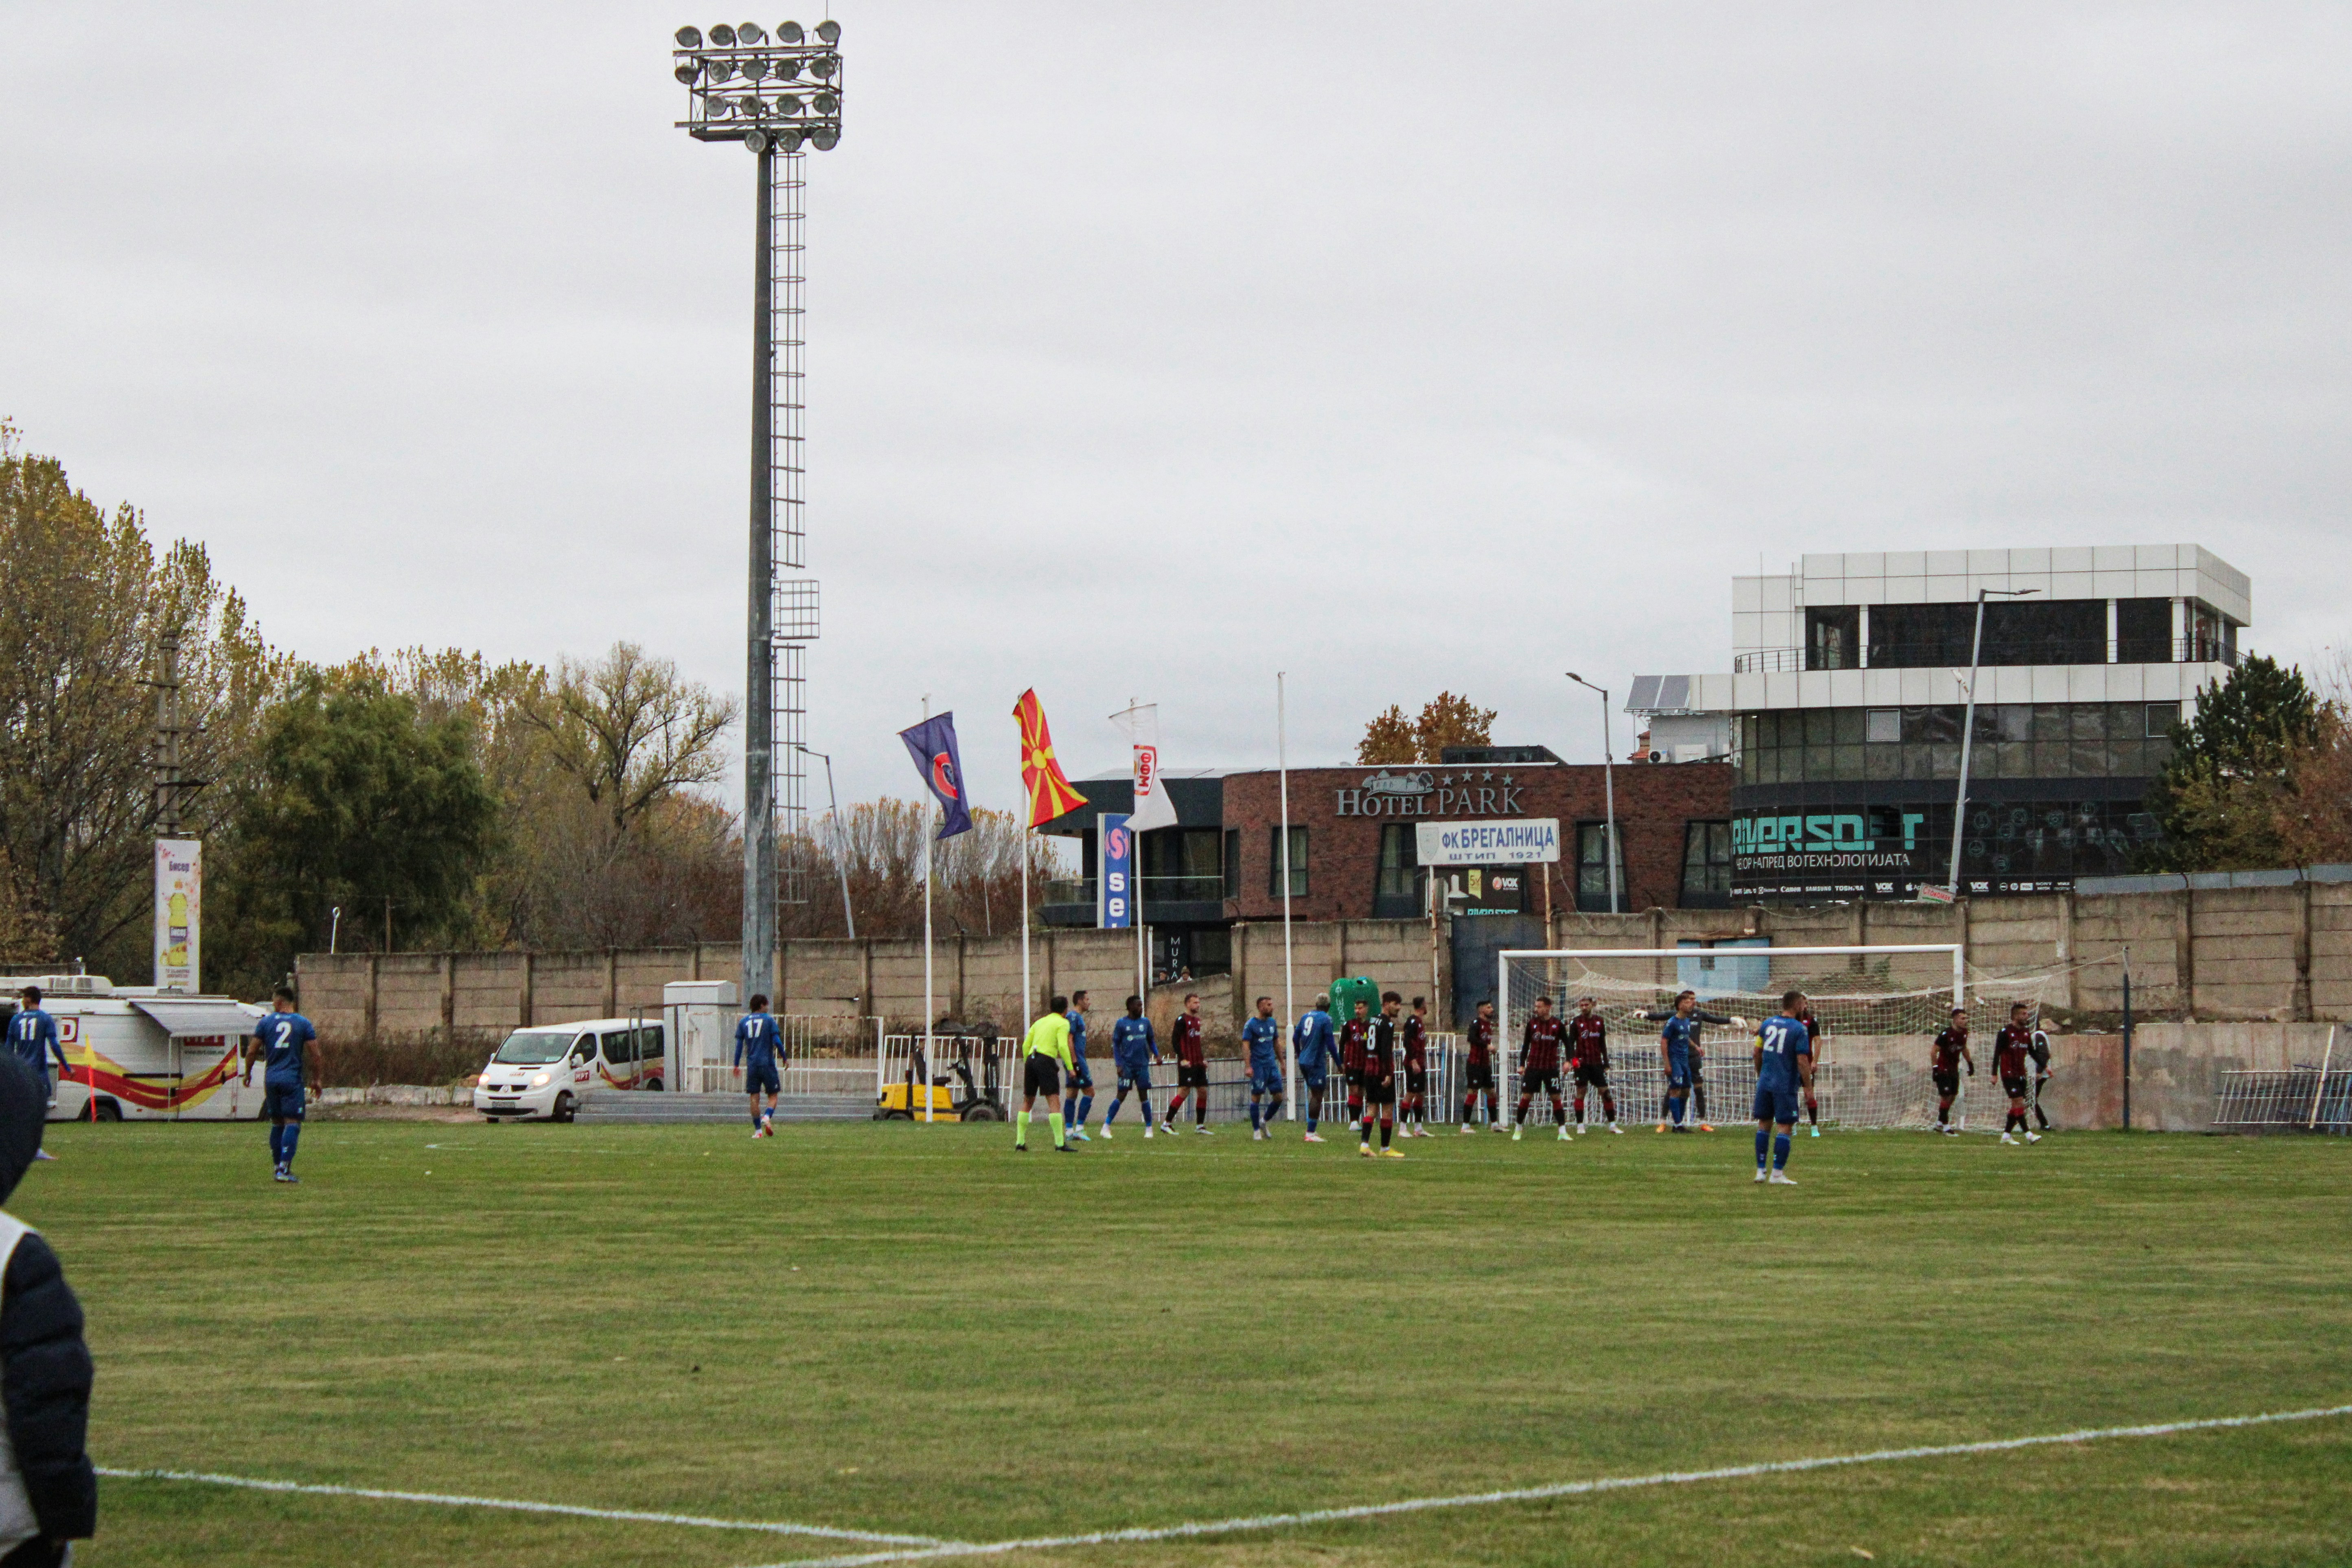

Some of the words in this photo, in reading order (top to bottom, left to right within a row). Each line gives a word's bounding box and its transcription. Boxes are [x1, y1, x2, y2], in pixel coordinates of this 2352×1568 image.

[1437, 787, 1524, 815] PARK
[1442, 832, 1459, 849] ФК
[1461, 826, 1554, 851] БРЕГАЛНИЦА
[1449, 852, 1496, 860] ШТИП
[1509, 851, 1541, 859] 1921
[1736, 857, 1752, 870] ЧЕОР
[1753, 856, 1785, 869] НАПРЕД
[1787, 856, 1802, 867] ВО
[1804, 853, 1910, 867] ТЕХНОЛОГИЈАТА
[1502, 878, 1518, 887] VOX
[1171, 936, 1180, 979] MURA
[19, 1018, 37, 1040] 11
[274, 1021, 291, 1048] 2
[745, 1018, 763, 1038] 17
[1303, 1016, 1314, 1036] 9
[1367, 1025, 1376, 1050] 8
[1763, 1025, 1787, 1054] 21
